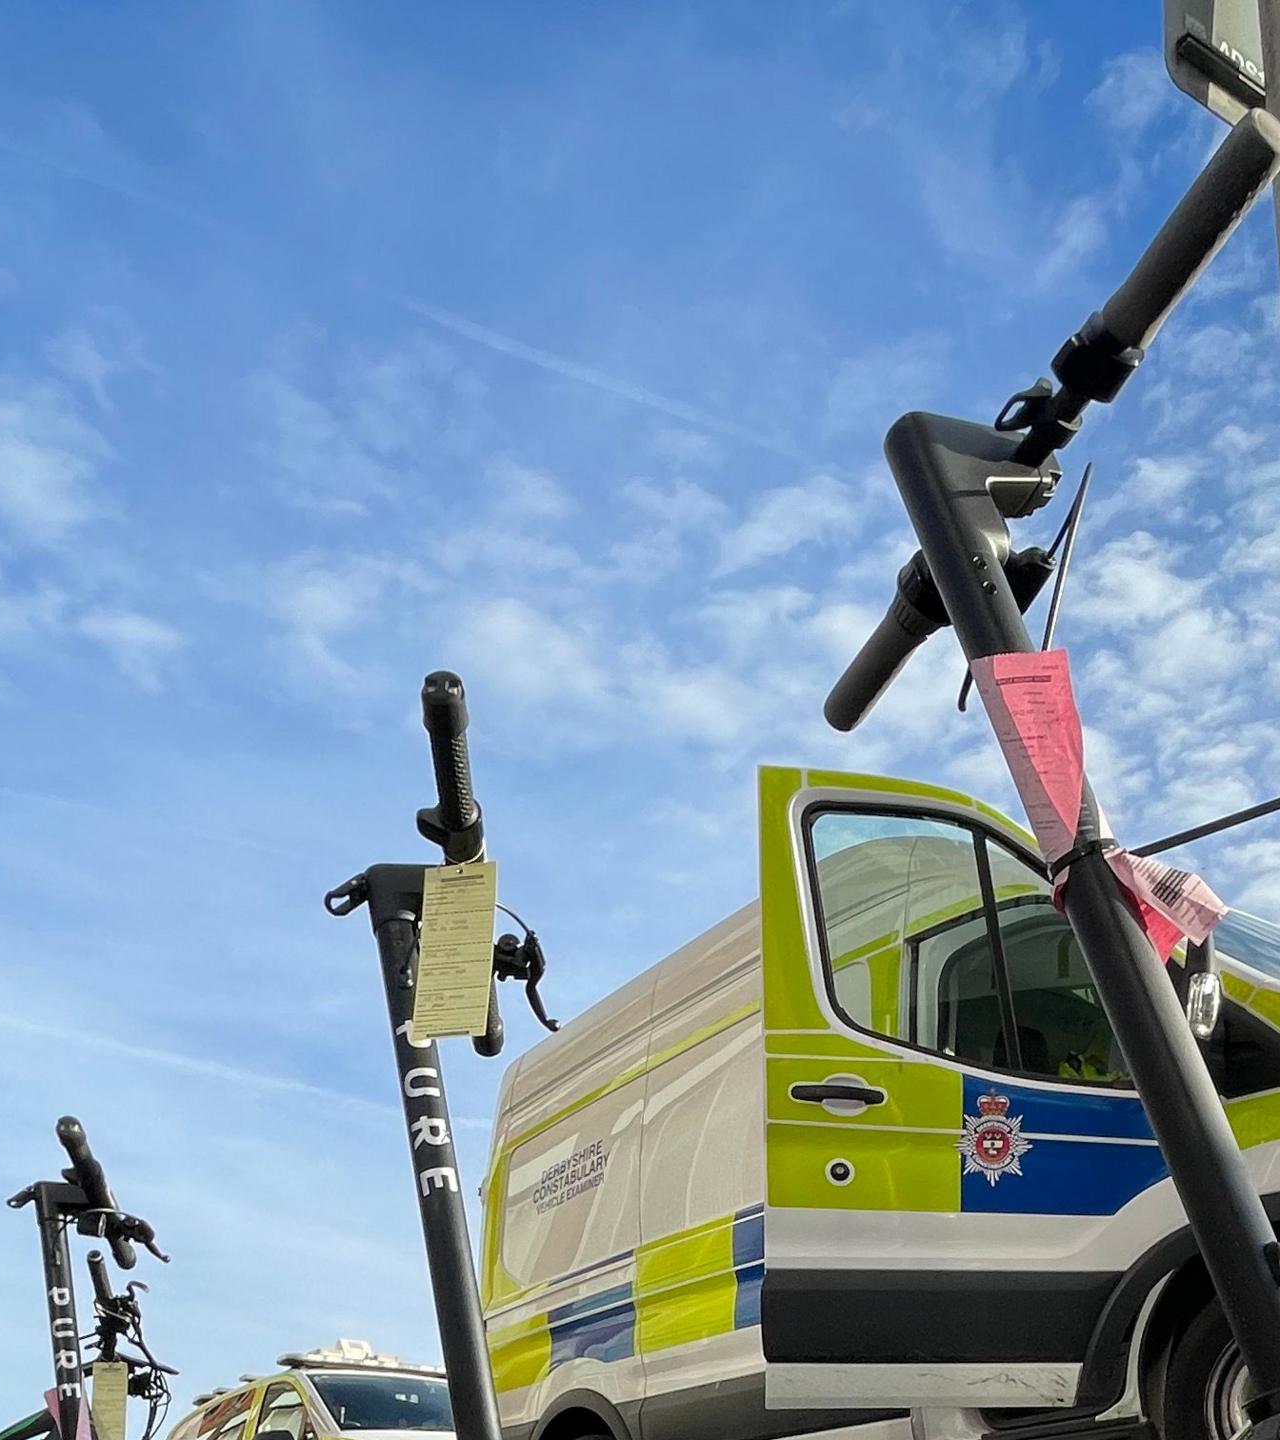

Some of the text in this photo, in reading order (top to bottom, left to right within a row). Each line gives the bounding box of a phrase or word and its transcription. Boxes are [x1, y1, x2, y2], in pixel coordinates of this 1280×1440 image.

[396, 1020, 459, 1197] PURE
[533, 1152, 610, 1204] CONSTABULARY
[541, 1140, 603, 1185] DERBYSHIRE
[535, 1172, 605, 1216] VEHICLE EXAMINER
[48, 1286, 82, 1401] PURE
